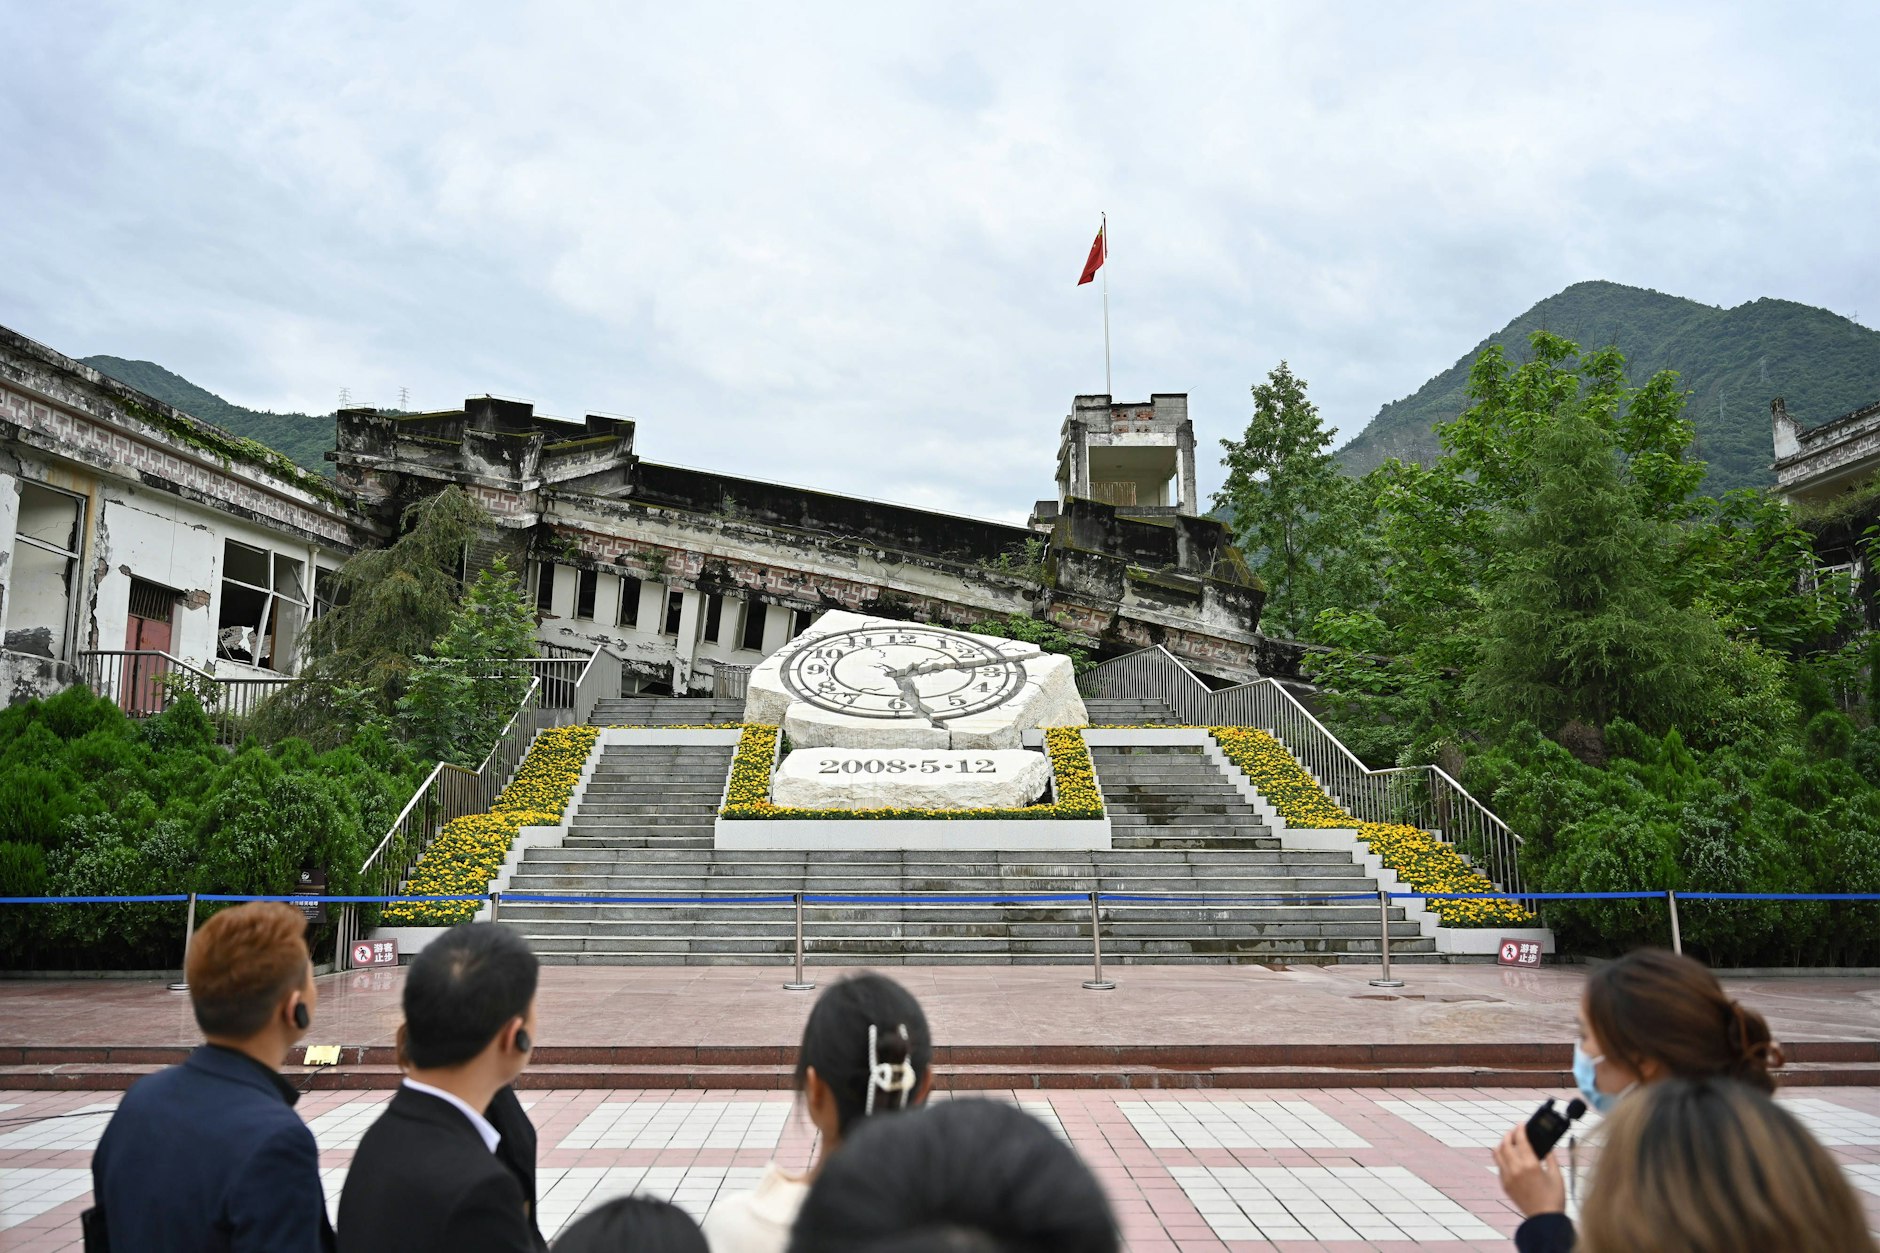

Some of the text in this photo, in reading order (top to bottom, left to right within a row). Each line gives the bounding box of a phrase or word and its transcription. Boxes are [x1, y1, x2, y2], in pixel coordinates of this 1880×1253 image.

[847, 637, 872, 647] 11
[889, 634, 917, 644] 12
[937, 639, 951, 649] 1
[812, 649, 844, 659] 10
[958, 648, 975, 658] 2
[807, 664, 825, 675] 9
[983, 666, 1001, 677] 3
[818, 681, 837, 692] 8
[972, 681, 991, 693] 4
[844, 692, 863, 705] 7
[888, 698, 907, 710] 6
[948, 694, 967, 706] 5
[373, 943, 393, 953] 游客
[1520, 943, 1539, 954] 游客
[374, 952, 394, 963] 止步
[1518, 953, 1537, 964] 止步
